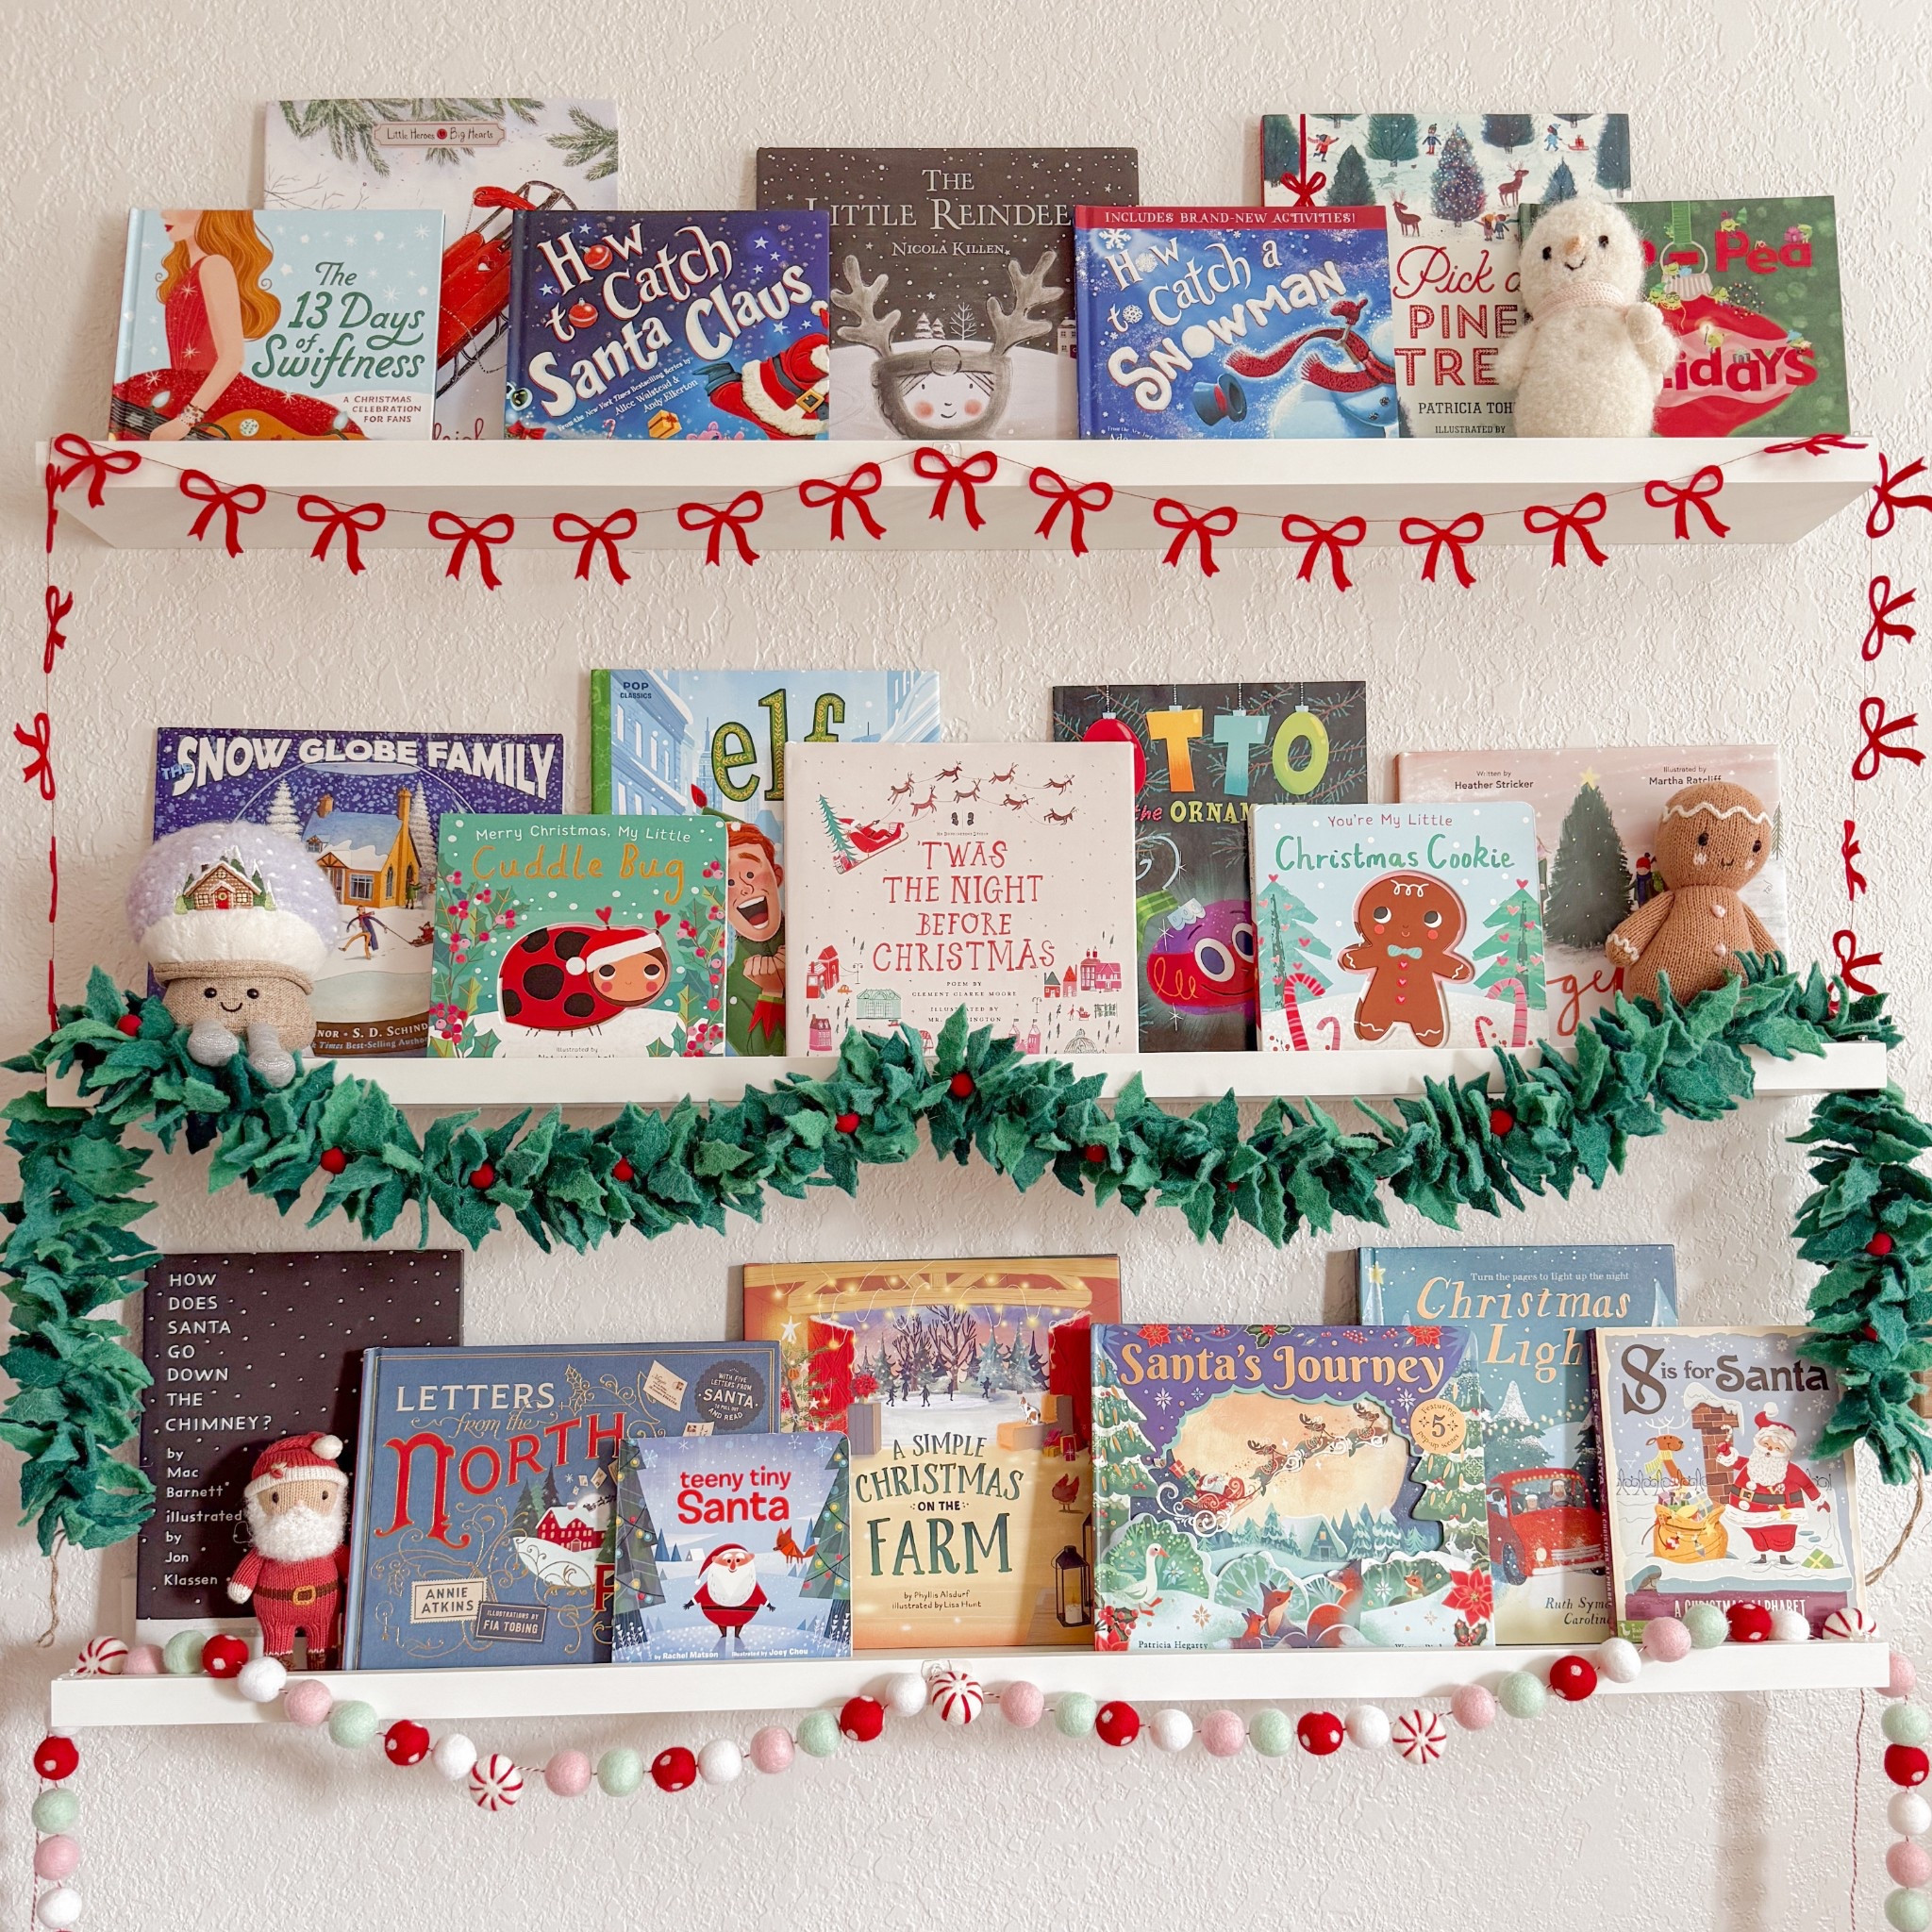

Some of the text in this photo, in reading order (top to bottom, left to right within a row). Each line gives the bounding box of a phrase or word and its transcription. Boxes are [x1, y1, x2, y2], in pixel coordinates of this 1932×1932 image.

[387, 124, 493, 142] Little Heroes Big Hearts
[922, 169, 974, 191] THE
[930, 198, 1074, 230] REINDEE
[1105, 211, 1356, 224] INCLUDES BRAND-NEW ACTIVITIES!
[891, 242, 1005, 256] NICOLA KILLEN
[537, 223, 643, 295] How
[1106, 237, 1179, 291] How
[315, 261, 357, 287] The
[1392, 245, 1495, 299] Pick
[545, 225, 732, 342] to Catch
[1108, 240, 1283, 332] to Catch a
[288, 291, 425, 350] 13 Days
[1409, 305, 1518, 339] PINE
[296, 334, 320, 353] of
[528, 265, 812, 418] Santa Claus
[252, 332, 425, 390] Swiftness
[1394, 348, 1499, 386] TRE
[643, 397, 664, 413] Andy
[1419, 402, 1481, 414] PATRICIA
[1435, 425, 1506, 434] ILLUSTRATED BY
[160, 763, 193, 780] THE
[172, 736, 555, 800] SNOW GLOBE FAMILY
[1455, 780, 1534, 789] Heather Stricker
[1649, 776, 1683, 785] Martha
[1328, 813, 1453, 828] You're My Little
[476, 824, 691, 843] Merry Christmas, My Little
[917, 841, 1008, 869] 'TWAS
[1275, 834, 1515, 871] Christmas Cookie
[473, 842, 685, 906] Cuddle Bug
[883, 875, 1043, 904] THE NIGHT
[916, 912, 1011, 936] BEFORE
[873, 939, 1055, 972] CHRISTMAS
[169, 1274, 217, 1287] HOW
[1471, 1273, 1493, 1281] Turn
[1495, 1273, 1509, 1281] the
[1513, 1274, 1537, 1282] pages
[1551, 1273, 1573, 1282] light
[1575, 1274, 1588, 1282] up
[1606, 1272, 1628, 1281] night
[169, 1296, 218, 1310] DOES
[1416, 1276, 1630, 1320] Christmas
[167, 1321, 231, 1335] SANTA
[168, 1345, 195, 1358] GO
[1482, 1324, 1583, 1383] Ligh
[167, 1368, 228, 1382] DOWN
[1120, 1342, 1444, 1394] Santa's Journey
[711, 1379, 735, 1388] LETTERS
[1621, 1343, 1829, 1414] S is for Santa
[166, 1392, 203, 1407] THE
[396, 1382, 555, 1412] LETTERS
[703, 1389, 753, 1408] SANTA
[708, 1407, 742, 1421] AND READ
[1422, 1404, 1457, 1417] Featuring
[165, 1415, 272, 1431] CHIMNEY?
[448, 1409, 540, 1441] from the
[1432, 1414, 1445, 1437] 5
[893, 1431, 988, 1460] A SIMPLE
[1416, 1431, 1458, 1450] pop-up scenes
[167, 1448, 184, 1460] by
[167, 1467, 199, 1478] Mac
[680, 1465, 791, 1491] teeny tiny
[166, 1486, 223, 1498] Barnett
[856, 1463, 1024, 1503] CHRISTMAS
[676, 1489, 790, 1524] Santa
[918, 1501, 960, 1511] ON THE
[165, 1509, 242, 1523] illustrated
[165, 1532, 181, 1544] by
[866, 1512, 1013, 1576] FARM
[165, 1552, 189, 1563] Jon
[164, 1574, 218, 1586] Klassen
[425, 1587, 468, 1600] ANNIE
[905, 1590, 970, 1601] by Phyllis Alsdurf
[422, 1600, 474, 1614] ATKINS
[935, 1601, 942, 1611] by
[1544, 1597, 1574, 1609] Ruth
[487, 1610, 529, 1619] ILLUSTRATIONS
[483, 1620, 538, 1634] FIA TOBING
[1174, 1641, 1208, 1650] Hegarty
